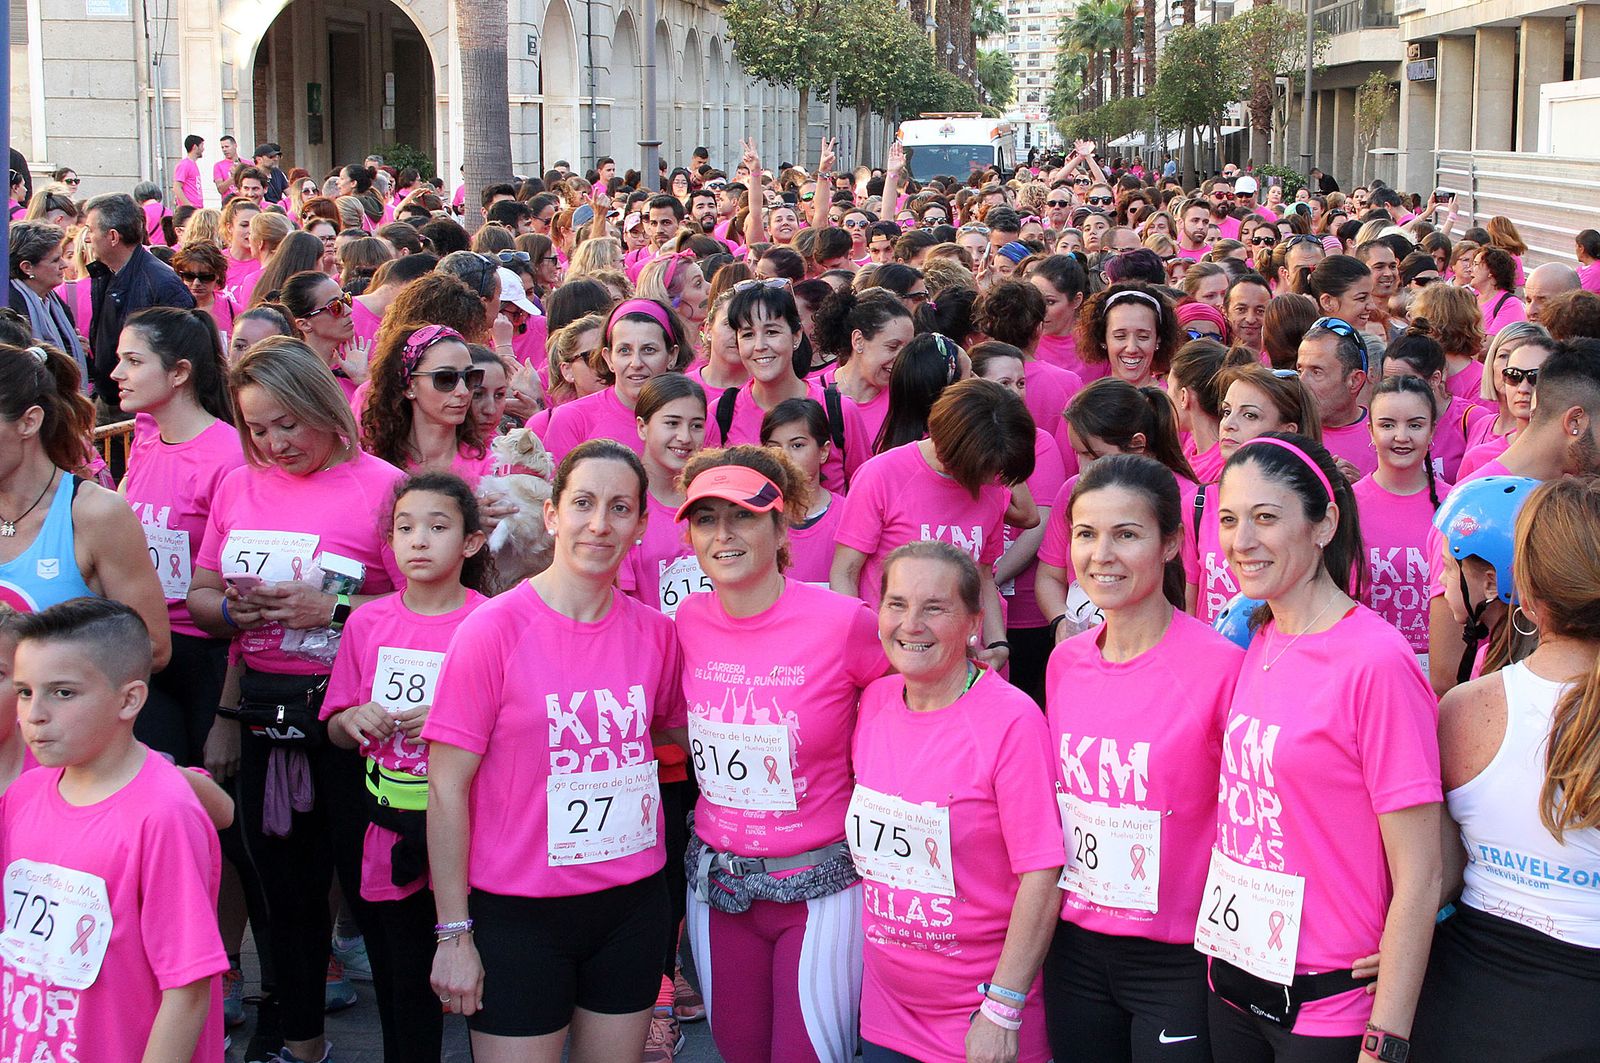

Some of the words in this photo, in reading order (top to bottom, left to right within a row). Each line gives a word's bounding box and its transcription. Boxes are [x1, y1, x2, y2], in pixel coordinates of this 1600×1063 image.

[271, 538, 280, 546] de
[282, 538, 289, 546] la
[236, 550, 270, 575] 57
[671, 565, 696, 575] Carrera
[664, 576, 714, 606] 615
[393, 656, 424, 667] Carrera
[426, 660, 438, 668] de
[707, 661, 746, 675] CARRERA
[778, 665, 805, 676] PINK
[385, 672, 426, 703] 58
[695, 668, 703, 678] DE
[703, 670, 712, 681] LA
[713, 672, 744, 685] MUJER
[745, 678, 752, 686] &
[754, 676, 805, 686] RUNNING
[545, 685, 647, 748] KM
[249, 725, 306, 740] FILA
[698, 724, 726, 740] Carrera
[728, 731, 740, 741] de
[742, 733, 751, 743] la
[754, 735, 782, 745] Mujer
[692, 738, 748, 781] 816
[1060, 733, 1151, 802] KM
[570, 780, 608, 791] Carrera
[611, 777, 622, 788] de
[625, 776, 633, 785] la
[568, 796, 614, 834] 27
[864, 798, 891, 815] Carrera
[893, 808, 903, 818] de
[904, 811, 912, 821] la
[916, 815, 942, 827] Mujer
[927, 826, 943, 835] 2019
[1094, 816, 1106, 827] de
[1109, 818, 1119, 828] la
[1122, 820, 1152, 832] Mujer
[853, 814, 912, 858] 175
[1136, 833, 1153, 841] 2019
[1074, 826, 1098, 870] 28
[65, 880, 74, 893] la
[1238, 876, 1248, 888] de
[1251, 878, 1260, 891] la
[1264, 882, 1296, 898] Mujer
[1485, 865, 1550, 890] clickviaja.com
[1208, 885, 1240, 932] 26
[1276, 898, 1294, 908] 2019
[13, 890, 59, 942] 725
[898, 928, 910, 937] de
[913, 930, 922, 939] la
[926, 932, 956, 942] Mujer
